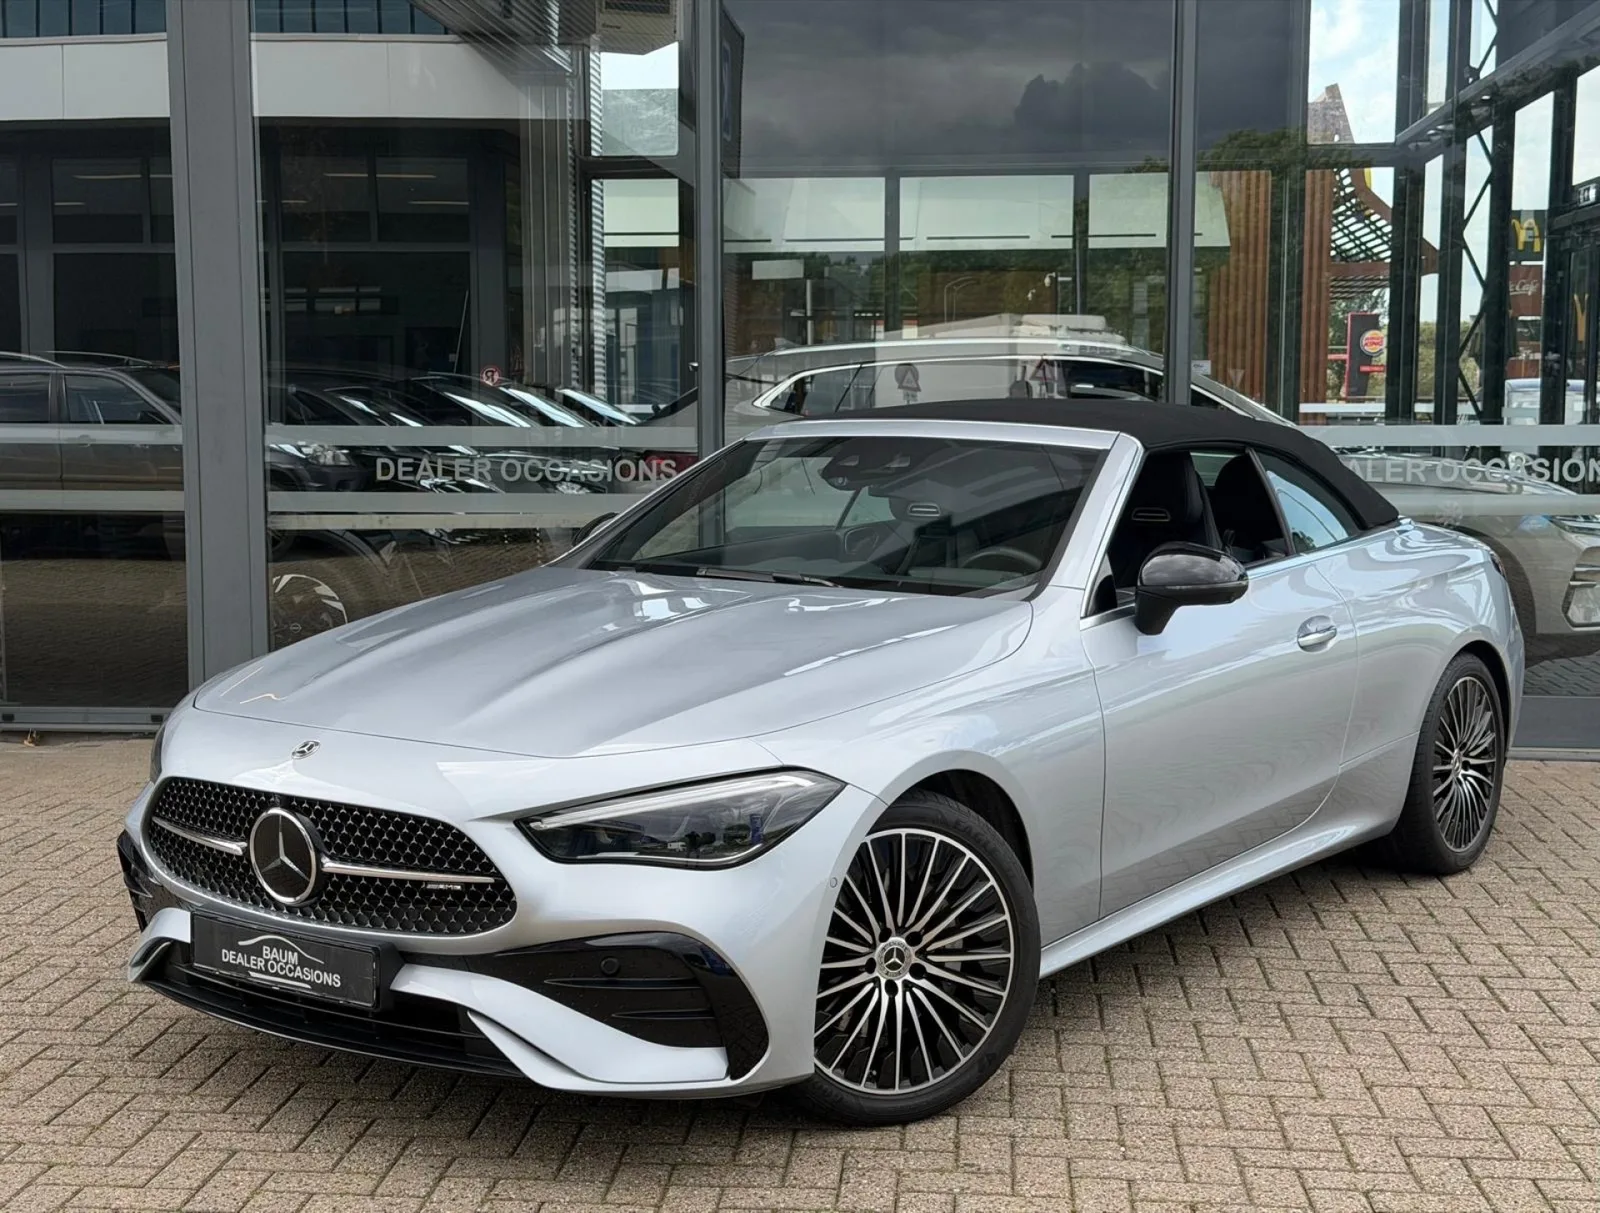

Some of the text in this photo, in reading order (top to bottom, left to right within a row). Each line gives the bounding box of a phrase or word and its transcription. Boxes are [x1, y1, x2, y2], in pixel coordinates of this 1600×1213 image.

[1509, 279, 1538, 293] cCafé
[376, 458, 677, 482] DEALER OCCASIONS
[1349, 458, 1600, 482] ALER OCCASION
[262, 945, 299, 965] BAUM
[221, 948, 342, 988] DEALER OCCASIONS
